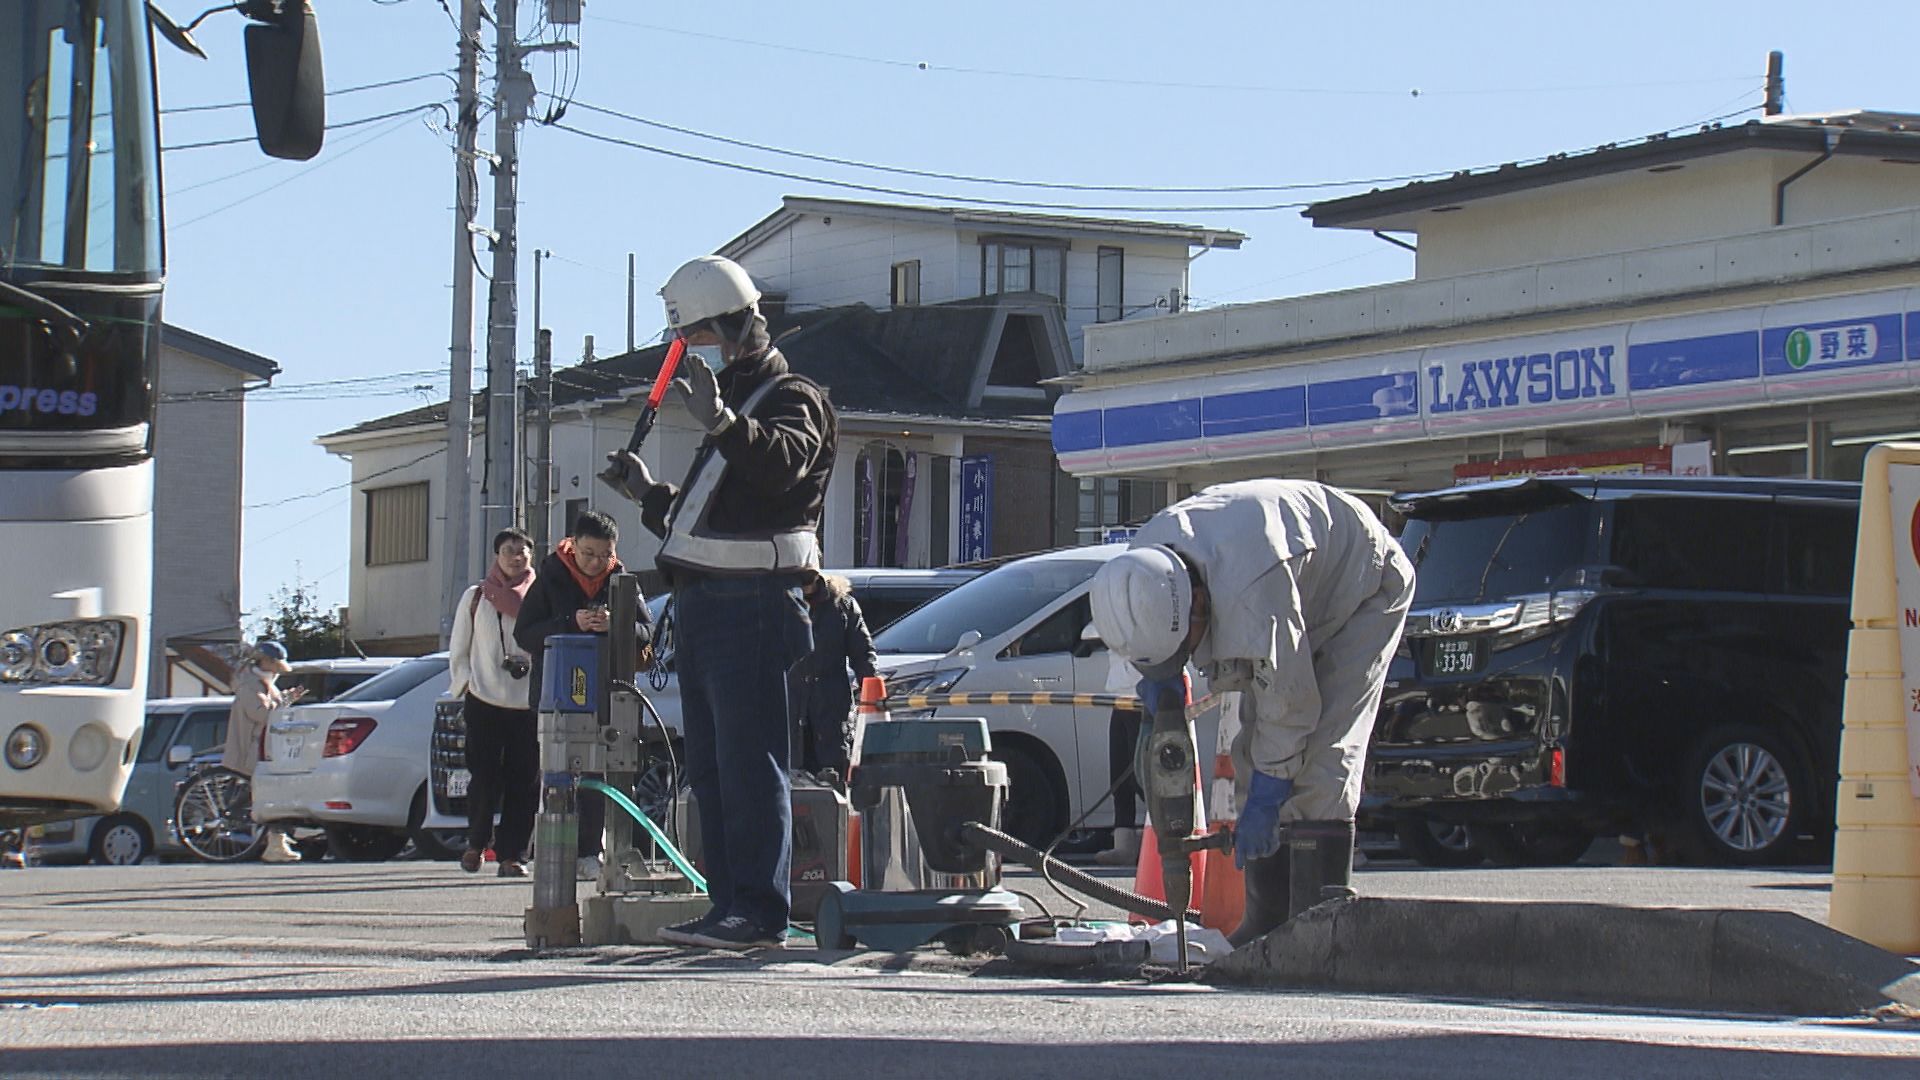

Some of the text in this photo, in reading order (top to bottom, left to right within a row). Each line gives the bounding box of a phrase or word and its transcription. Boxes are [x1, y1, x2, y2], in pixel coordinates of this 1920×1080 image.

[1820, 327, 1868, 359] 野菜
[1428, 345, 1616, 414] LAWSON
[0, 384, 98, 416] press
[1905, 607, 1920, 628] N
